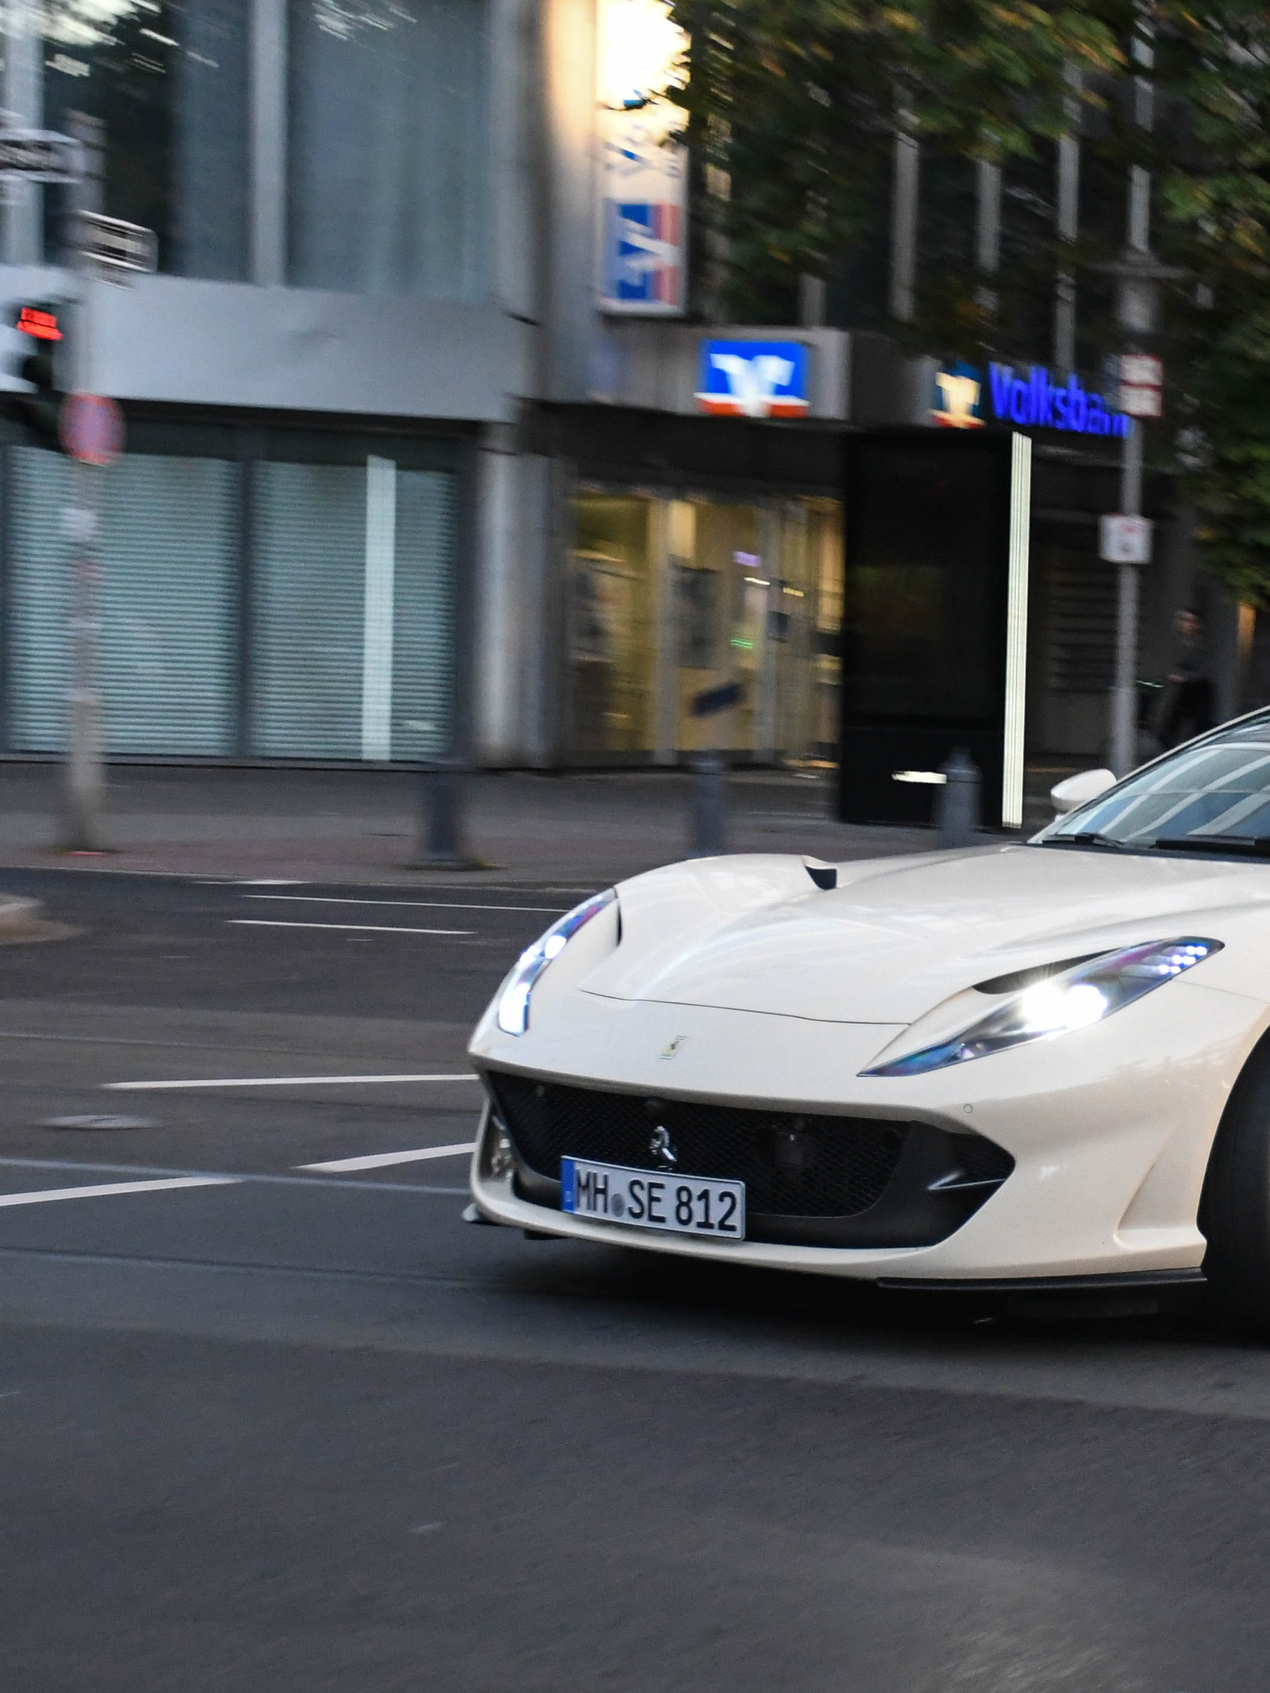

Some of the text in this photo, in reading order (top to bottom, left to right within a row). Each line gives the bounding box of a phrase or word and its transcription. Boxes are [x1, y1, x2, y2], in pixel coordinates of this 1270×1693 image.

[988, 361, 1132, 438] Volksban
[576, 1168, 738, 1232] MH SE 812
